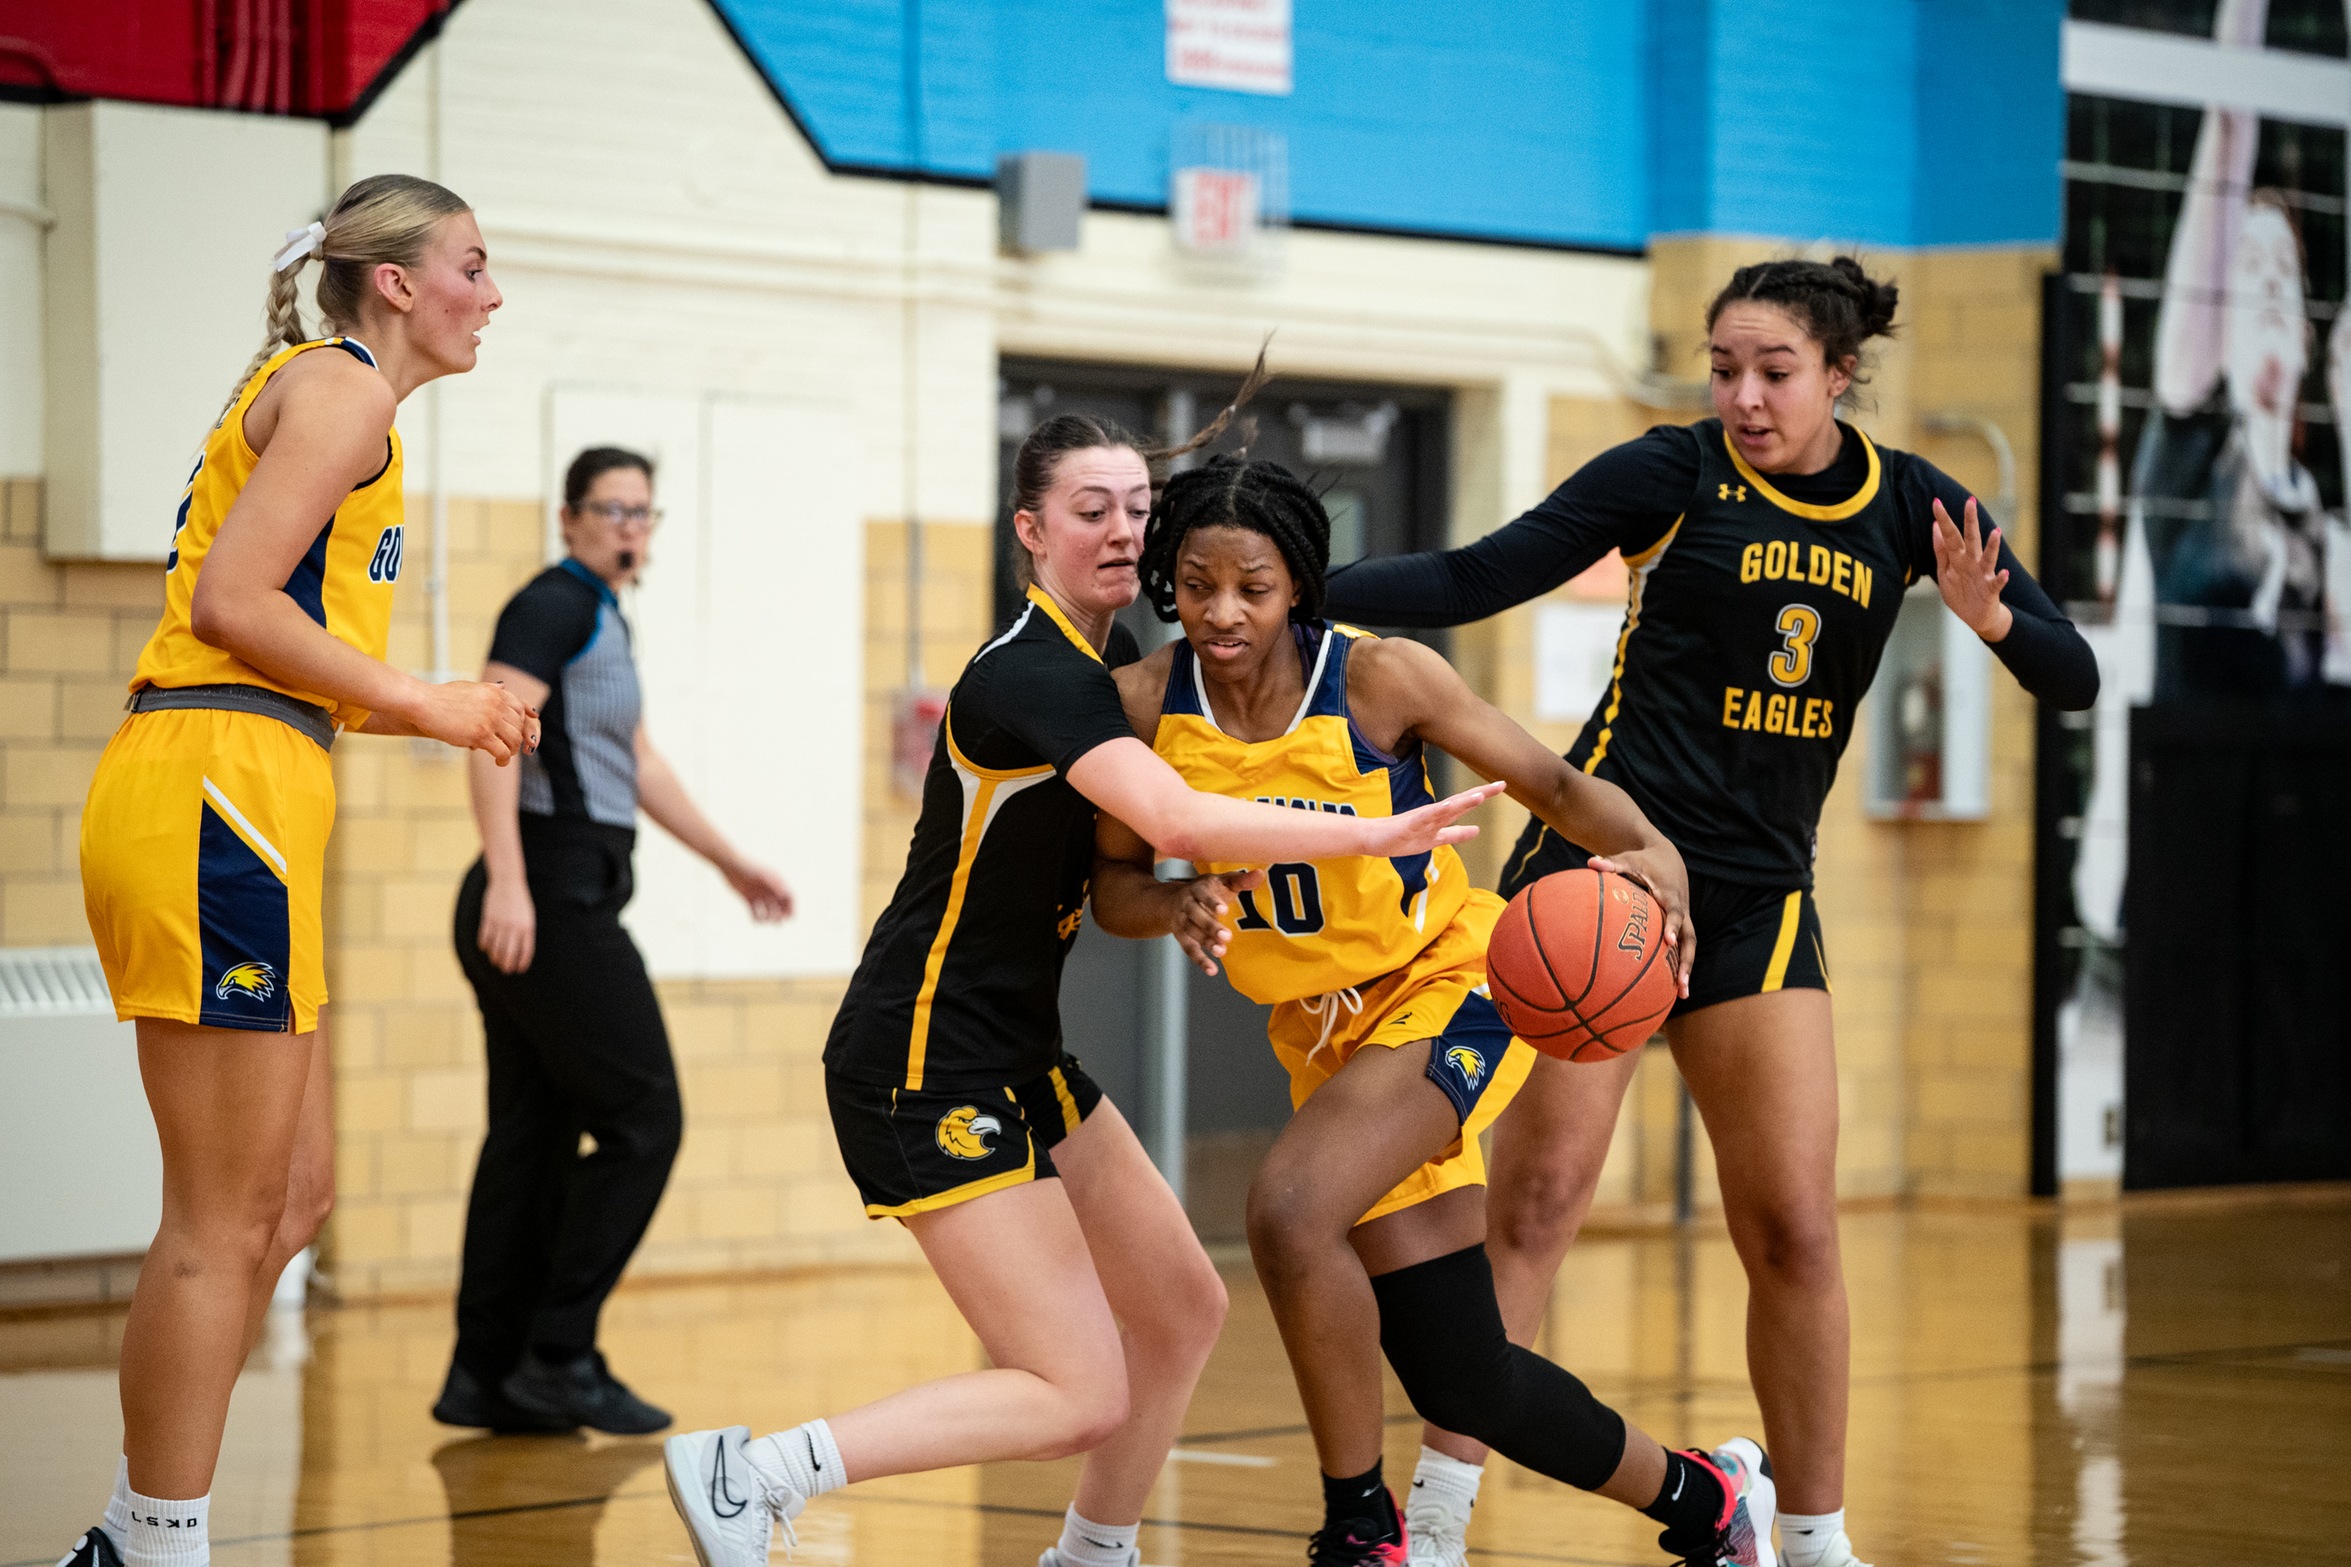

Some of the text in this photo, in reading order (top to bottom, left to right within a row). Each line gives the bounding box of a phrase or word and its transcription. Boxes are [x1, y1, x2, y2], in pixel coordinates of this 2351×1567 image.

[367, 524, 404, 584] GO
[1740, 540, 1873, 609] GOLDEN
[1767, 603, 1822, 688] 3
[1722, 686, 1834, 738] EAGLES
[1234, 861, 1325, 938] 10
[1617, 880, 1651, 961] SPALD
